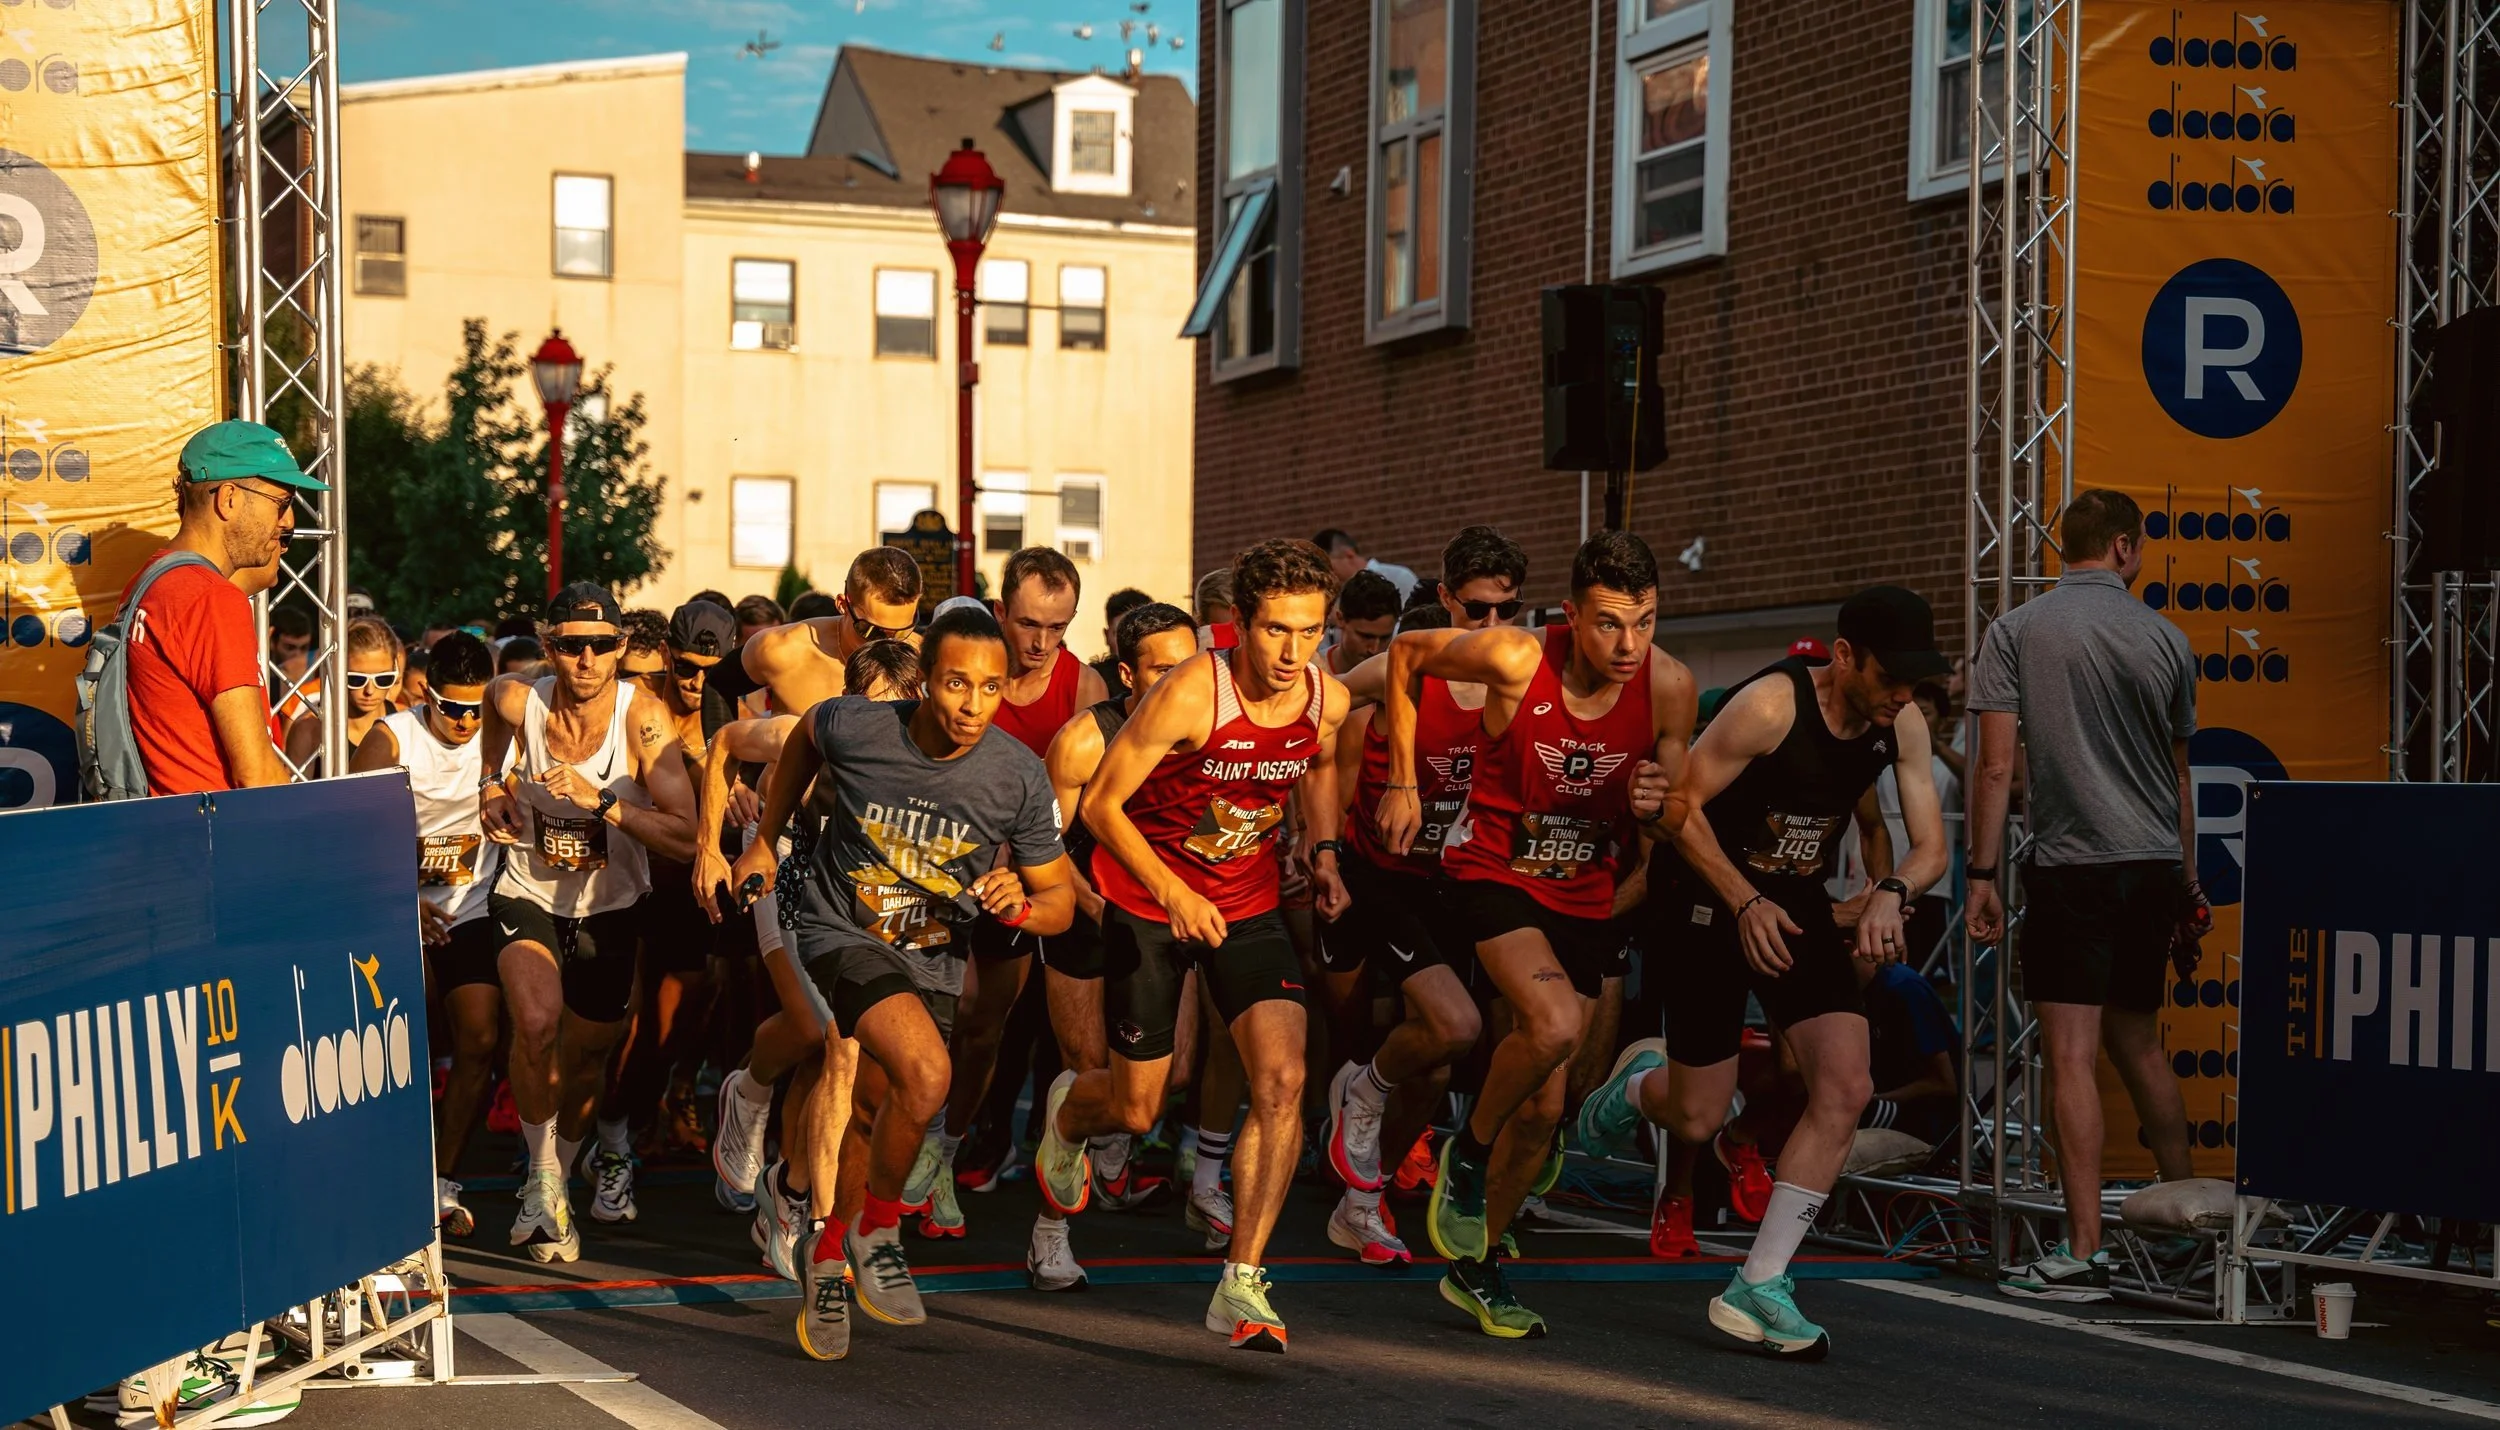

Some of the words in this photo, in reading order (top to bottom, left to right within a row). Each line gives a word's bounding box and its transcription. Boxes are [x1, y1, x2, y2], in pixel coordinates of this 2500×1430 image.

[2149, 8, 2296, 71] diadora
[2148, 81, 2295, 143] diadora
[2147, 153, 2294, 214] diadora
[2184, 296, 2265, 401] R
[2145, 483, 2290, 542] diadora
[2143, 555, 2289, 612] diadora
[1448, 745, 1477, 755] TRAC
[1560, 738, 1606, 753] TRACK
[1202, 758, 1251, 781] SAINT
[1252, 757, 1309, 781] JOSEPH'S
[1555, 784, 1592, 796] CLUB
[907, 796, 940, 810] THE
[1229, 805, 1258, 819] PHILLY
[1435, 800, 1460, 811] PHILLY
[541, 814, 565, 827] PHILLY
[861, 802, 970, 855] PHILLY
[1238, 821, 1256, 832] IRA
[1542, 815, 1571, 826] PHILLY
[1784, 815, 1812, 826] PHILLY
[424, 836, 448, 846] PHILLY
[545, 826, 585, 840] CAMERON
[1215, 827, 1261, 850] 710
[1425, 823, 1452, 841] 3
[1549, 828, 1580, 840] ETHAN
[1784, 828, 1823, 840] ZACHARY
[424, 845, 462, 857] GREGORIO
[543, 835, 591, 858] 955
[1523, 839, 1596, 861] 1386
[1771, 838, 1820, 860] 149
[419, 855, 460, 873] 441
[877, 885, 909, 896] PHILLY
[878, 906, 928, 934] 774
[2287, 928, 2308, 1056] THE
[202, 978, 239, 1046] 10
[281, 952, 412, 1124] diadora
[15, 986, 201, 1211] PHILLY
[211, 1077, 247, 1150] K
